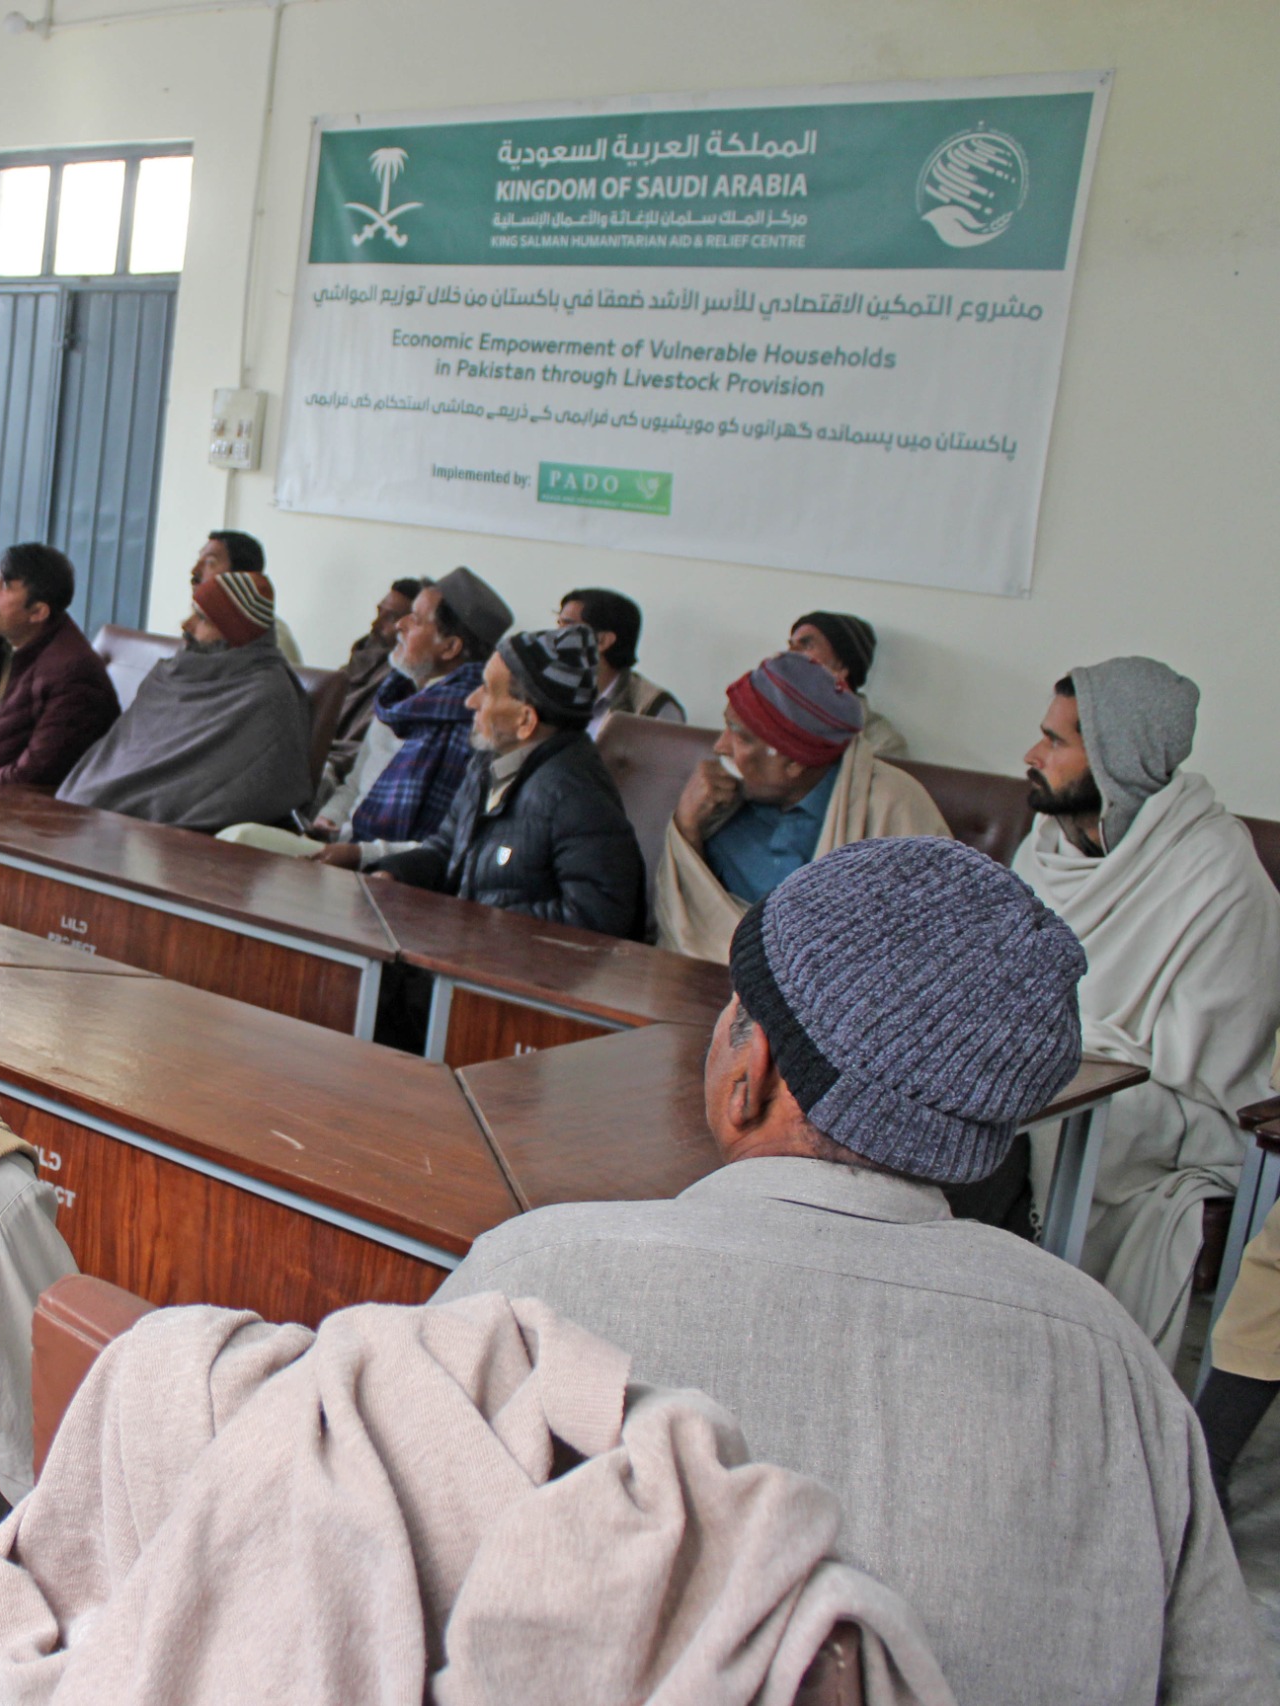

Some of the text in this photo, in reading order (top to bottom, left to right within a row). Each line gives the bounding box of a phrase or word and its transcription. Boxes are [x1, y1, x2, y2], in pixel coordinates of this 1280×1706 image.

[497, 130, 817, 171] المملكة العربية السعودية
[495, 172, 808, 201] KINGDOM OF SAUDI ARABIA
[491, 233, 806, 248] KING SALMAN HUMANITARIAN AID & RELIEF CENTRE
[380, 284, 425, 306] توزيع
[427, 285, 461, 306] خلال
[464, 290, 488, 308] من
[491, 287, 560, 312] باكستان
[563, 289, 593, 315] في
[647, 288, 700, 311] الأشد
[702, 289, 755, 315] للأسر
[760, 292, 863, 321] الاقتصادي
[867, 294, 952, 320] التمكين
[957, 295, 1043, 322] مشروع
[391, 329, 898, 369] Economic Empowerment of Vulnerable Households
[435, 360, 825, 397] in Pakistan through Livestock Provision
[431, 463, 531, 490] Implemented by:
[549, 470, 619, 494] PADO
